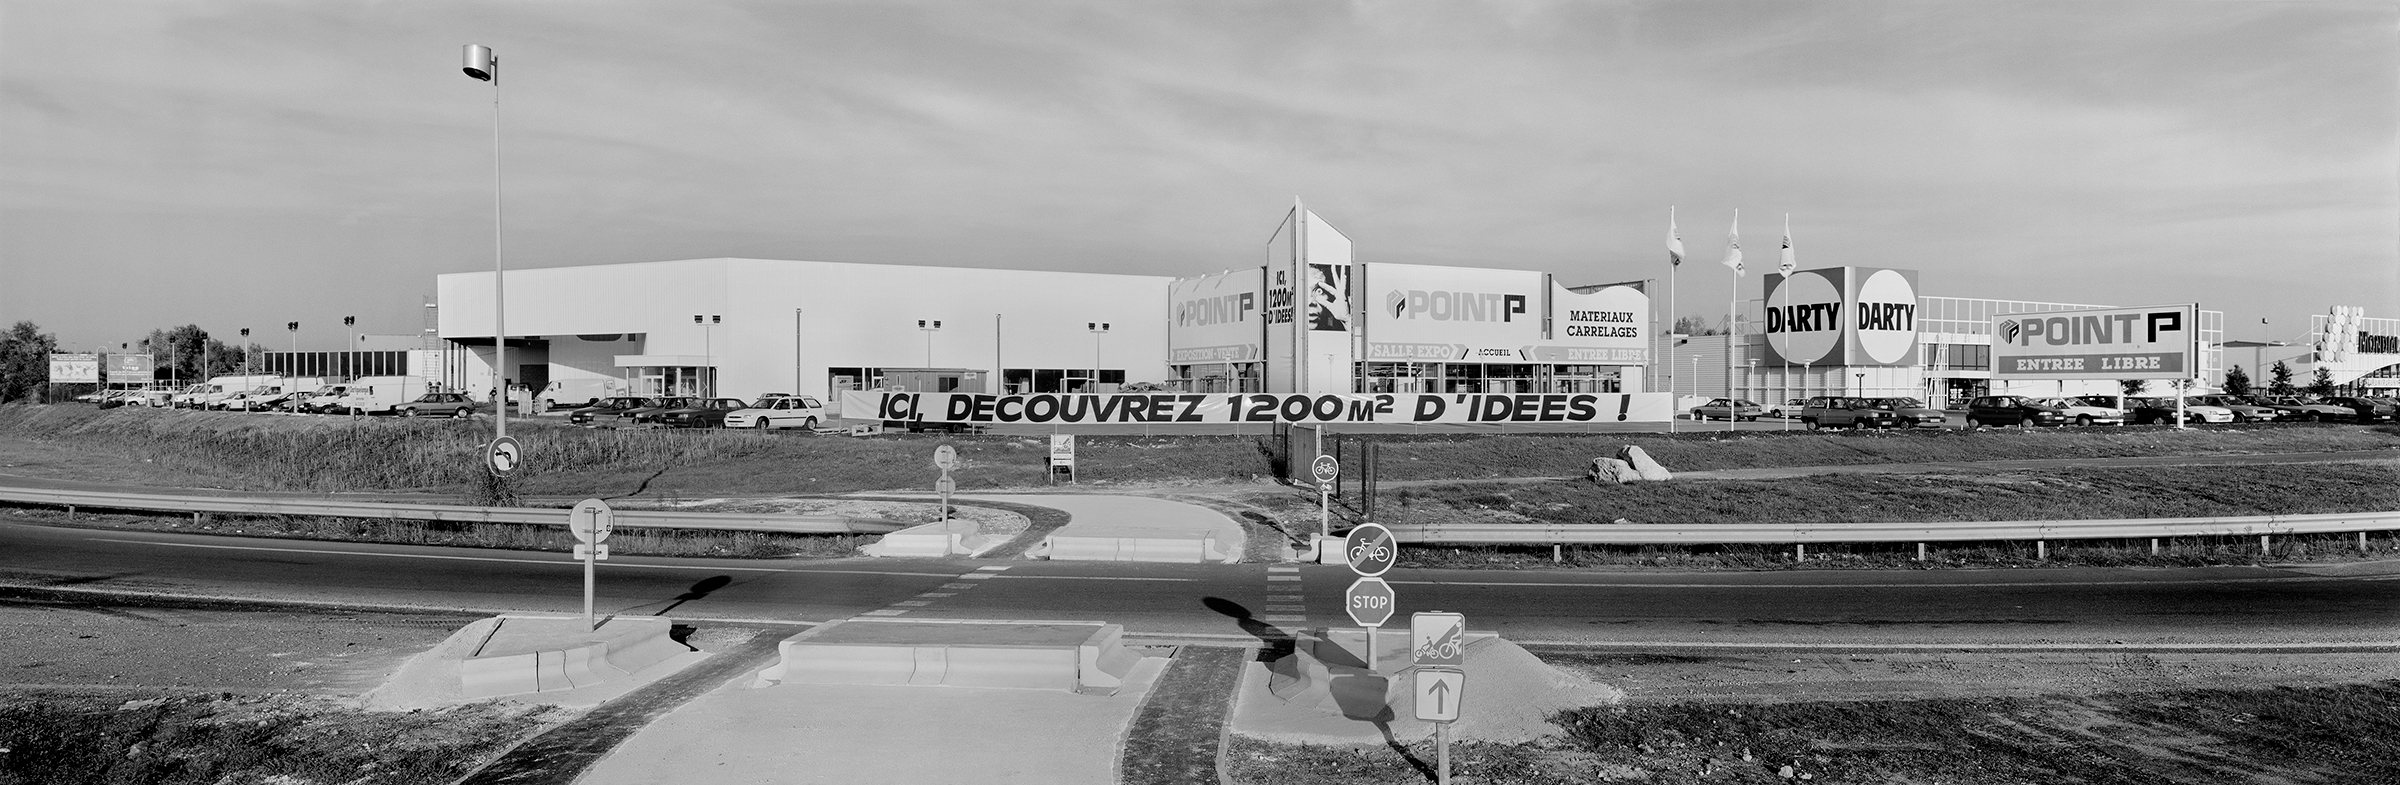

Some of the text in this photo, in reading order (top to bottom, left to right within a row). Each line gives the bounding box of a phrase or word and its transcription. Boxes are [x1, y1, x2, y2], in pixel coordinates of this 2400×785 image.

[1276, 270, 1287, 286] ICI,
[1569, 310, 1634, 323] MATERIAUX
[1767, 302, 1841, 333] DARTY
[1858, 302, 1915, 331] DARTY
[1566, 326, 1638, 338] CARRELAGES
[2021, 311, 2181, 346] POINT P
[1374, 344, 1450, 358] SALLE EXPO
[1478, 348, 1511, 357] ACCUEIL
[1567, 348, 1641, 361] ENTREE LIBRE
[2016, 356, 2161, 371] ENTREE LIBRE
[878, 393, 924, 423] ICI,
[947, 393, 1208, 423] DECOUVREZ
[1353, 595, 1388, 609] STOP
